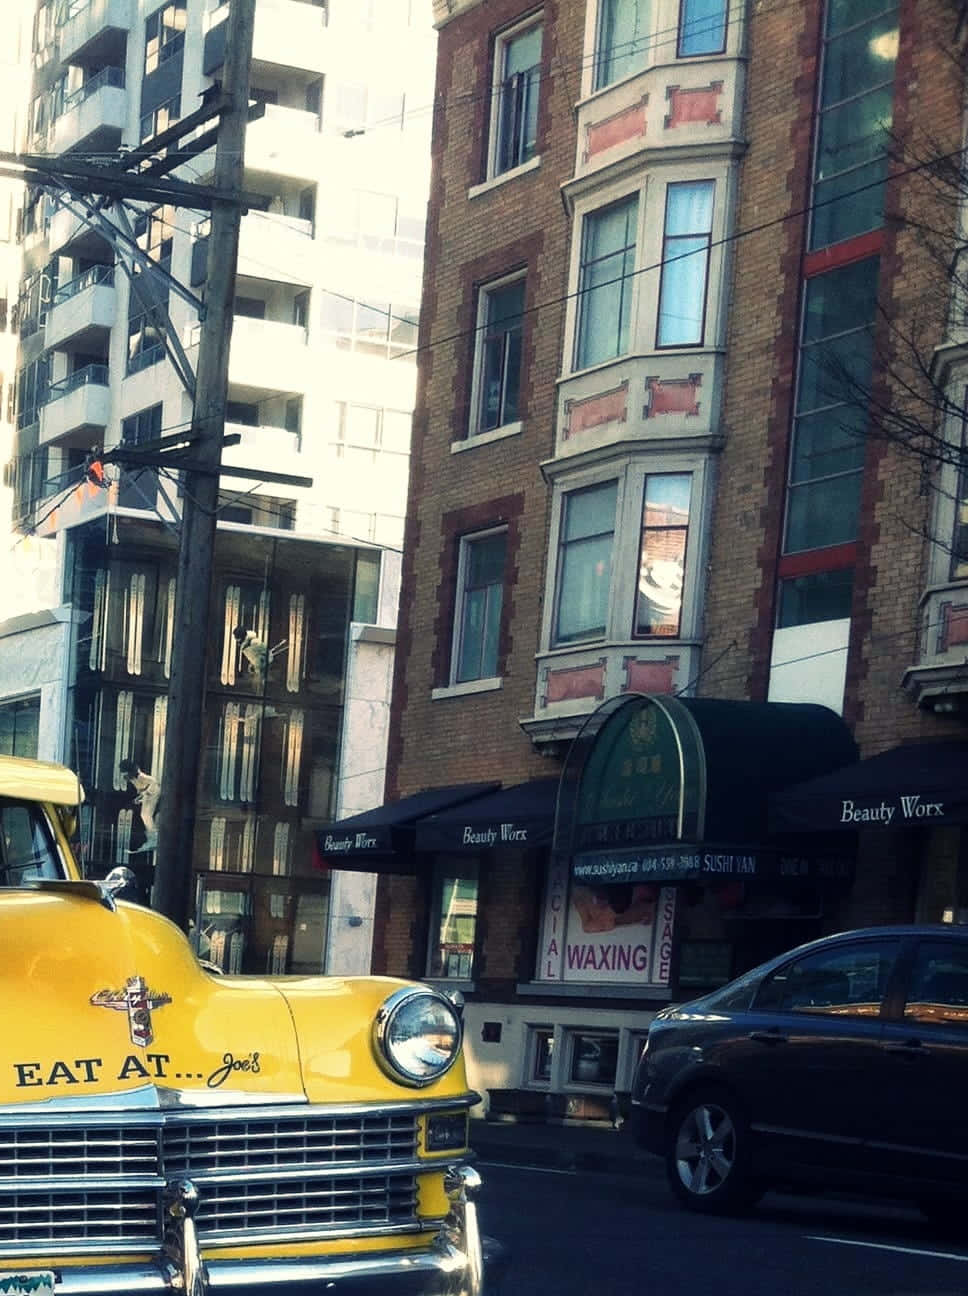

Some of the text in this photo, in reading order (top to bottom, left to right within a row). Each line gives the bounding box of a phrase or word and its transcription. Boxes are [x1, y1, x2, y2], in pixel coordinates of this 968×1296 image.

[839, 795, 945, 825] Beauty Worx
[324, 832, 377, 852] Beauty Worx
[463, 823, 528, 847] Beauty Worx
[703, 854, 734, 873] SUSHI
[736, 855, 756, 873] YAN
[567, 944, 648, 971] WAXING
[13, 1058, 102, 1087] EAT
[207, 1052, 261, 1088] Joe's
